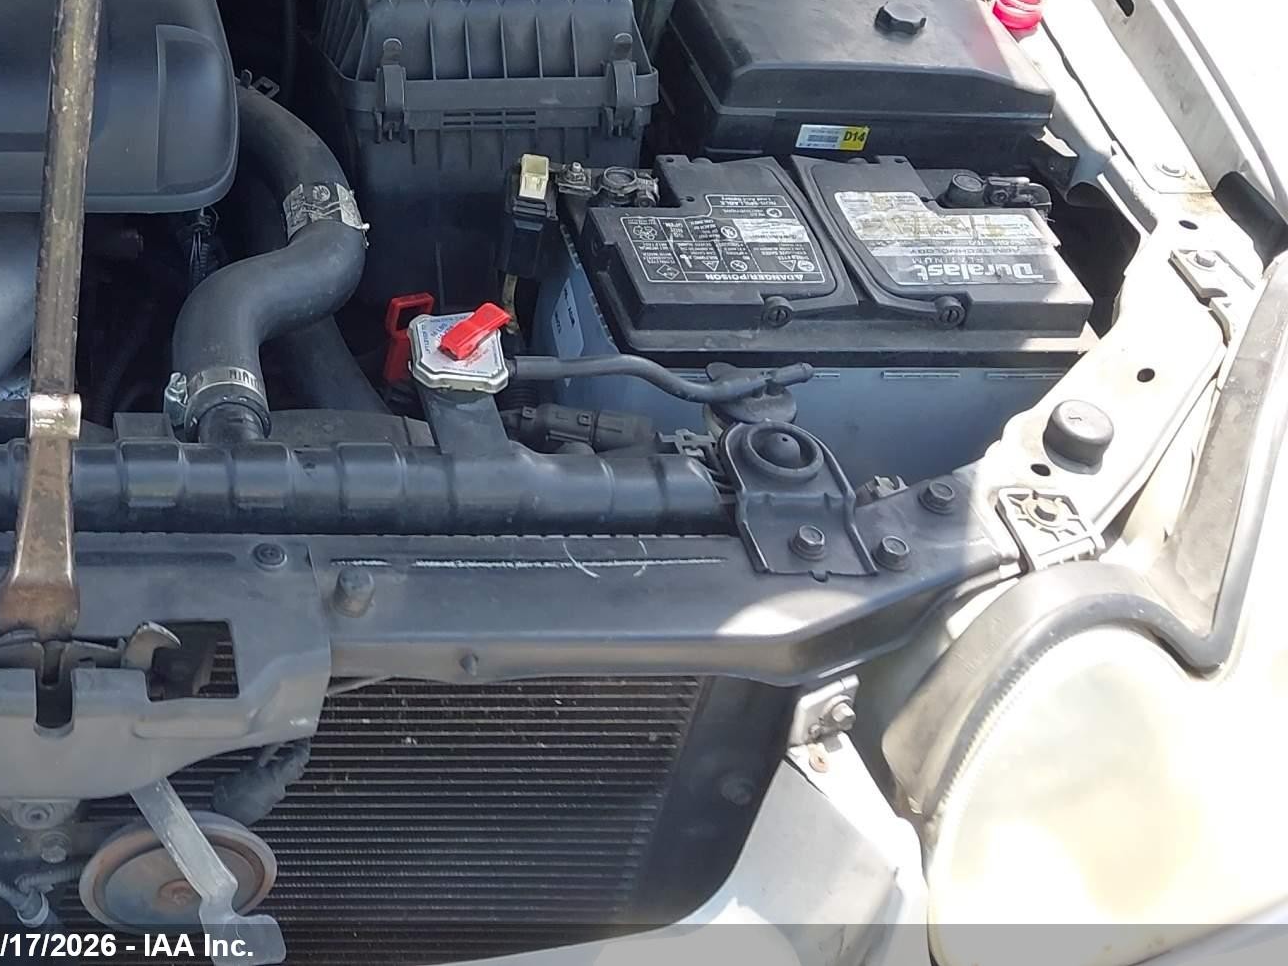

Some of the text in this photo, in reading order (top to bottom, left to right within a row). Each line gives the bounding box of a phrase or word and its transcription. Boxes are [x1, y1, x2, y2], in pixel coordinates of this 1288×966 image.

[843, 130, 866, 142] D14
[705, 273, 795, 281] DANGER/POISON
[913, 262, 1044, 280] Duralast
